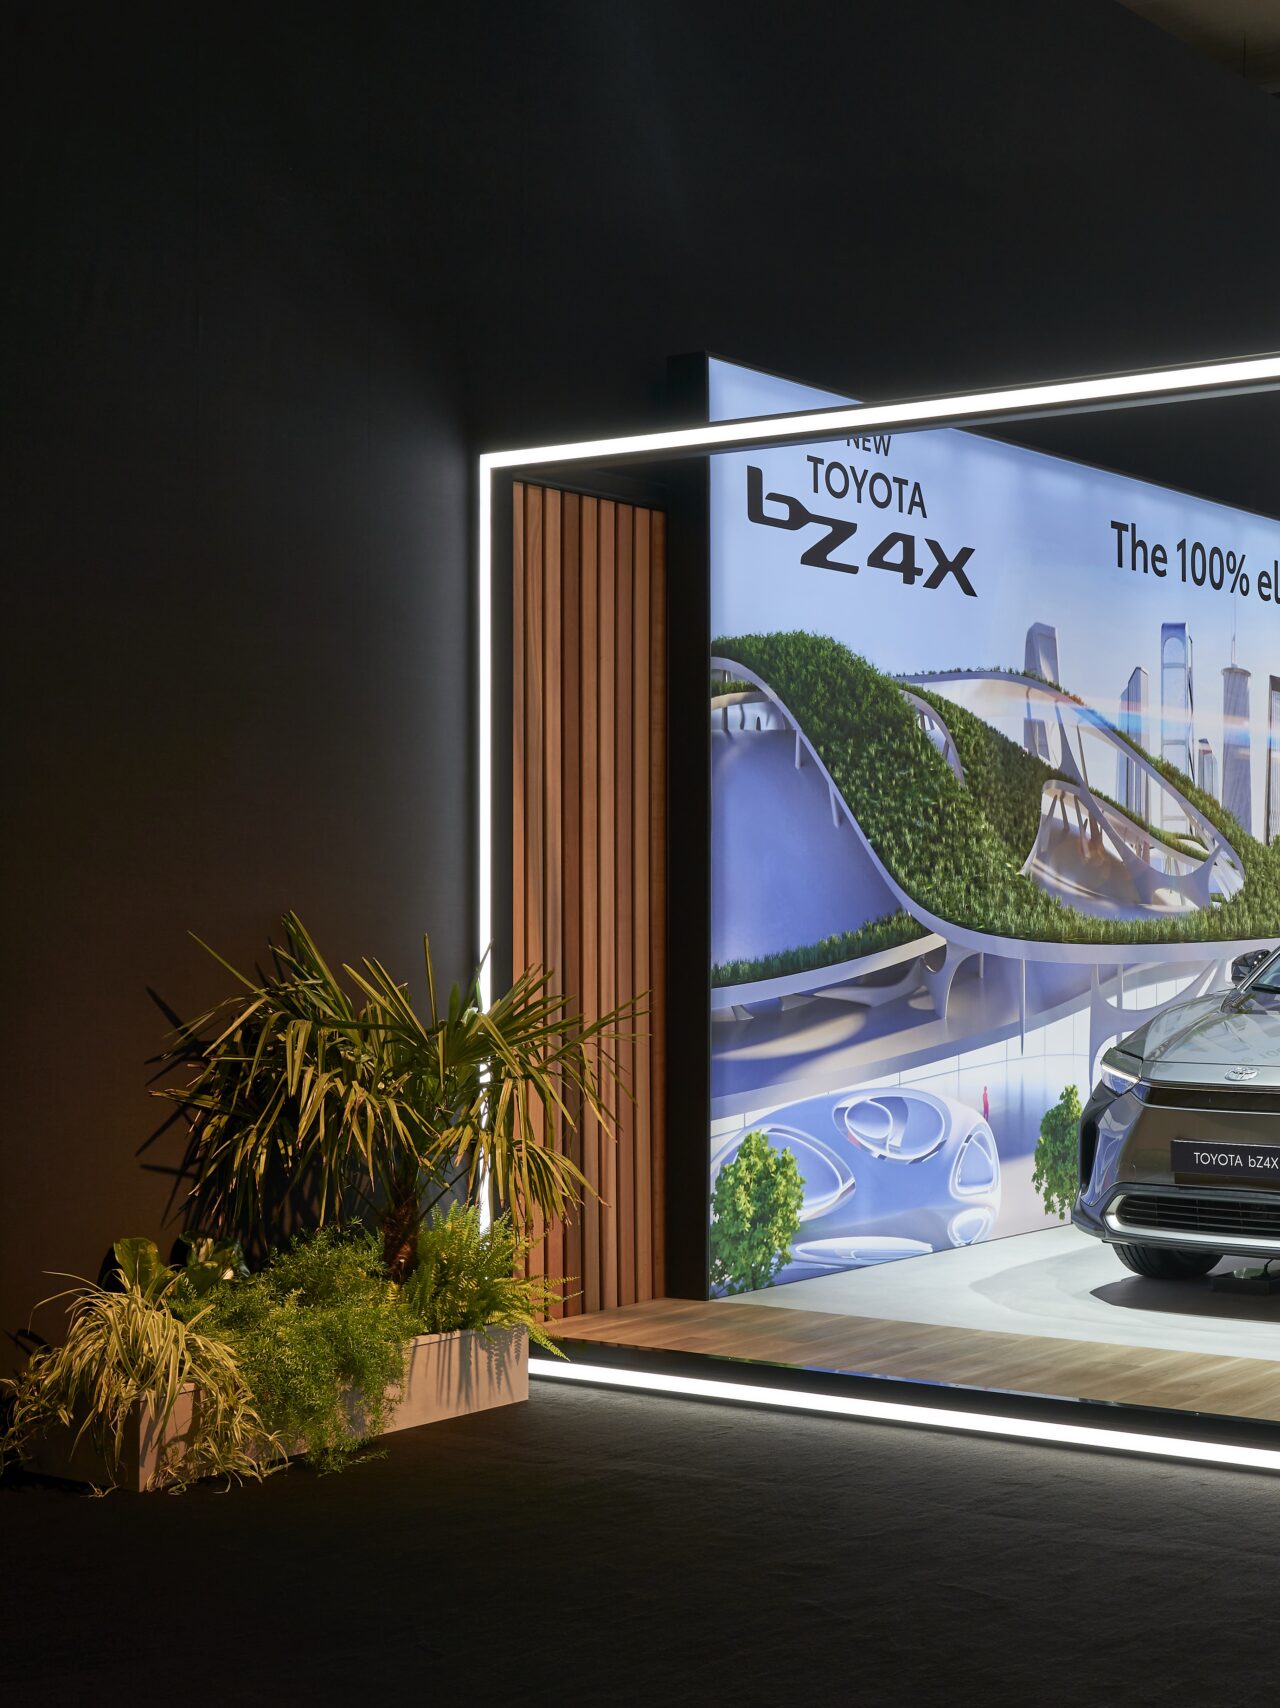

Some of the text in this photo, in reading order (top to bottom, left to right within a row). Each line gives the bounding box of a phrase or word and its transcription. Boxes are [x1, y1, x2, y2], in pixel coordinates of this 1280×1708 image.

[807, 455, 927, 519] TOYOTA
[747, 465, 978, 597] bZ4X
[1111, 520, 1168, 577] The
[1177, 538, 1250, 597] 100%
[1194, 1152, 1279, 1170] TOYOTA bZ4X
